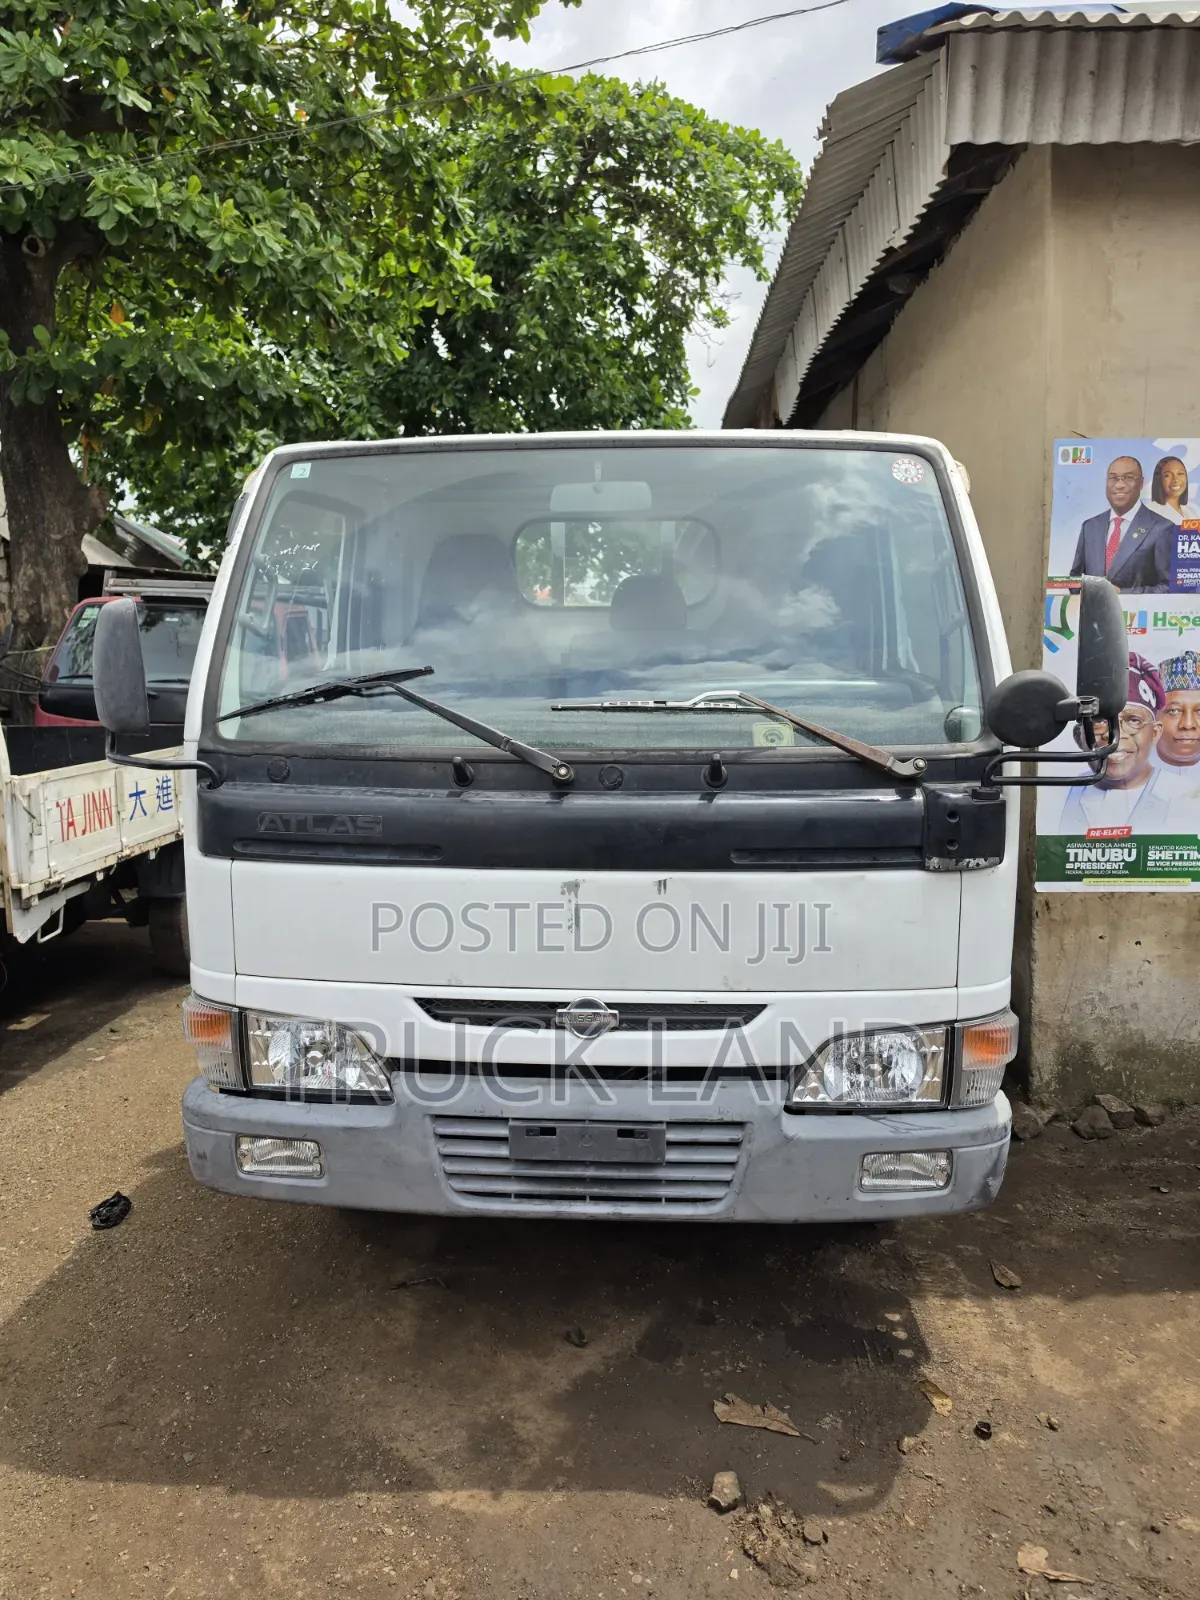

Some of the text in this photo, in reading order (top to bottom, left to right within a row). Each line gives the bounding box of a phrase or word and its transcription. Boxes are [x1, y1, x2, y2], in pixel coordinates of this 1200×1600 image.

[1183, 520, 1200, 529] VO
[128, 774, 173, 821] 大進
[259, 813, 380, 836] ATLAS
[1090, 828, 1129, 837] RE-ELECT
[1065, 848, 1137, 862] TINUBU
[1074, 862, 1125, 870] PRESIDENT
[562, 1013, 612, 1024] NISSAN
